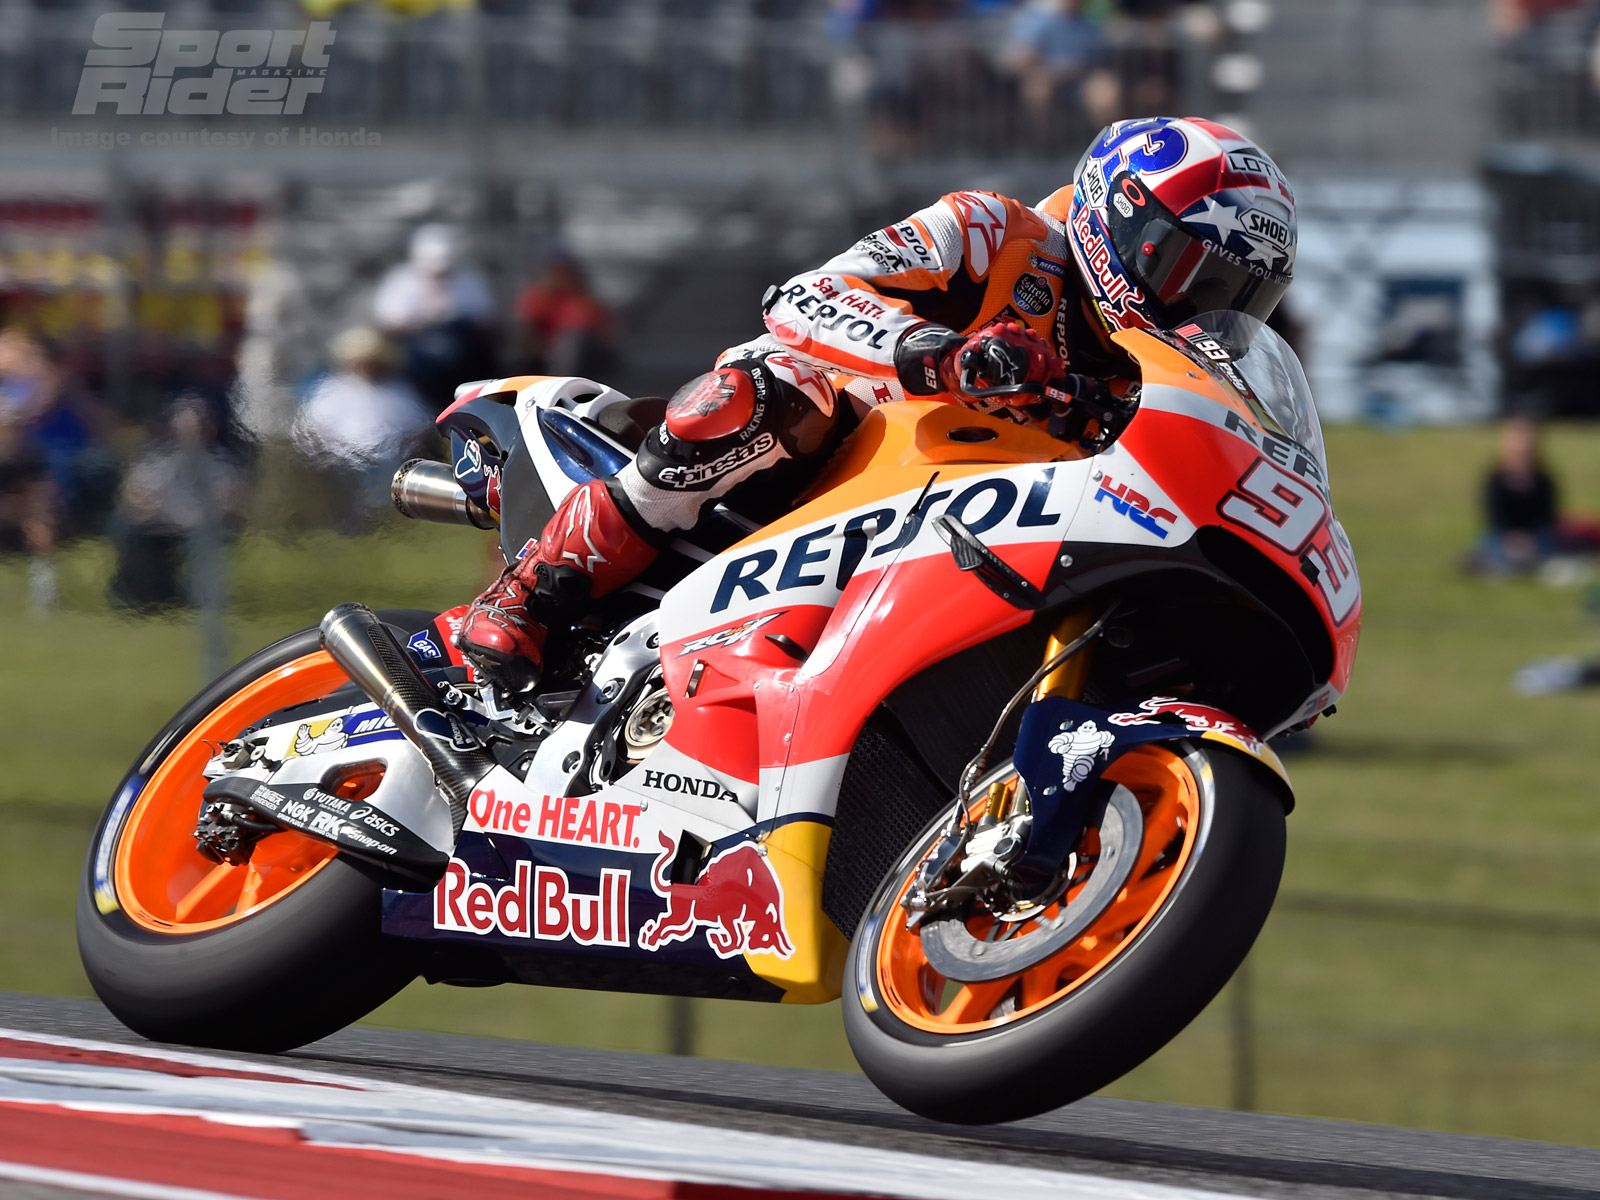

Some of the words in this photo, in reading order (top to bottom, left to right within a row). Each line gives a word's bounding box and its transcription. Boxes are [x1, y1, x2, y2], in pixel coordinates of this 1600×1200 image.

[1086, 165, 1104, 204] SHOEI
[1115, 197, 1131, 216] SHOEI
[1249, 213, 1288, 245] SHOEI
[1202, 239, 1242, 266] GIVES
[1248, 262, 1271, 280] YOU
[1016, 284, 1042, 313] Galicia
[1021, 276, 1051, 306] Estrella
[783, 284, 890, 350] REPSOL
[1057, 297, 1071, 367] REPSOL
[1196, 340, 1230, 359] 93
[751, 367, 767, 401] AHEAD
[739, 403, 766, 440] RACING
[658, 432, 775, 488] alpinestars
[1094, 474, 1178, 540] HRC
[709, 467, 1061, 614] REPSOL
[1217, 456, 1363, 627] 93
[413, 640, 437, 657] GAS
[312, 791, 351, 812] YUTAKA
[643, 769, 739, 802] HONDA
[281, 800, 315, 823] NGK
[311, 811, 346, 836] RK
[470, 789, 531, 833] One
[538, 795, 641, 848] HEART.
